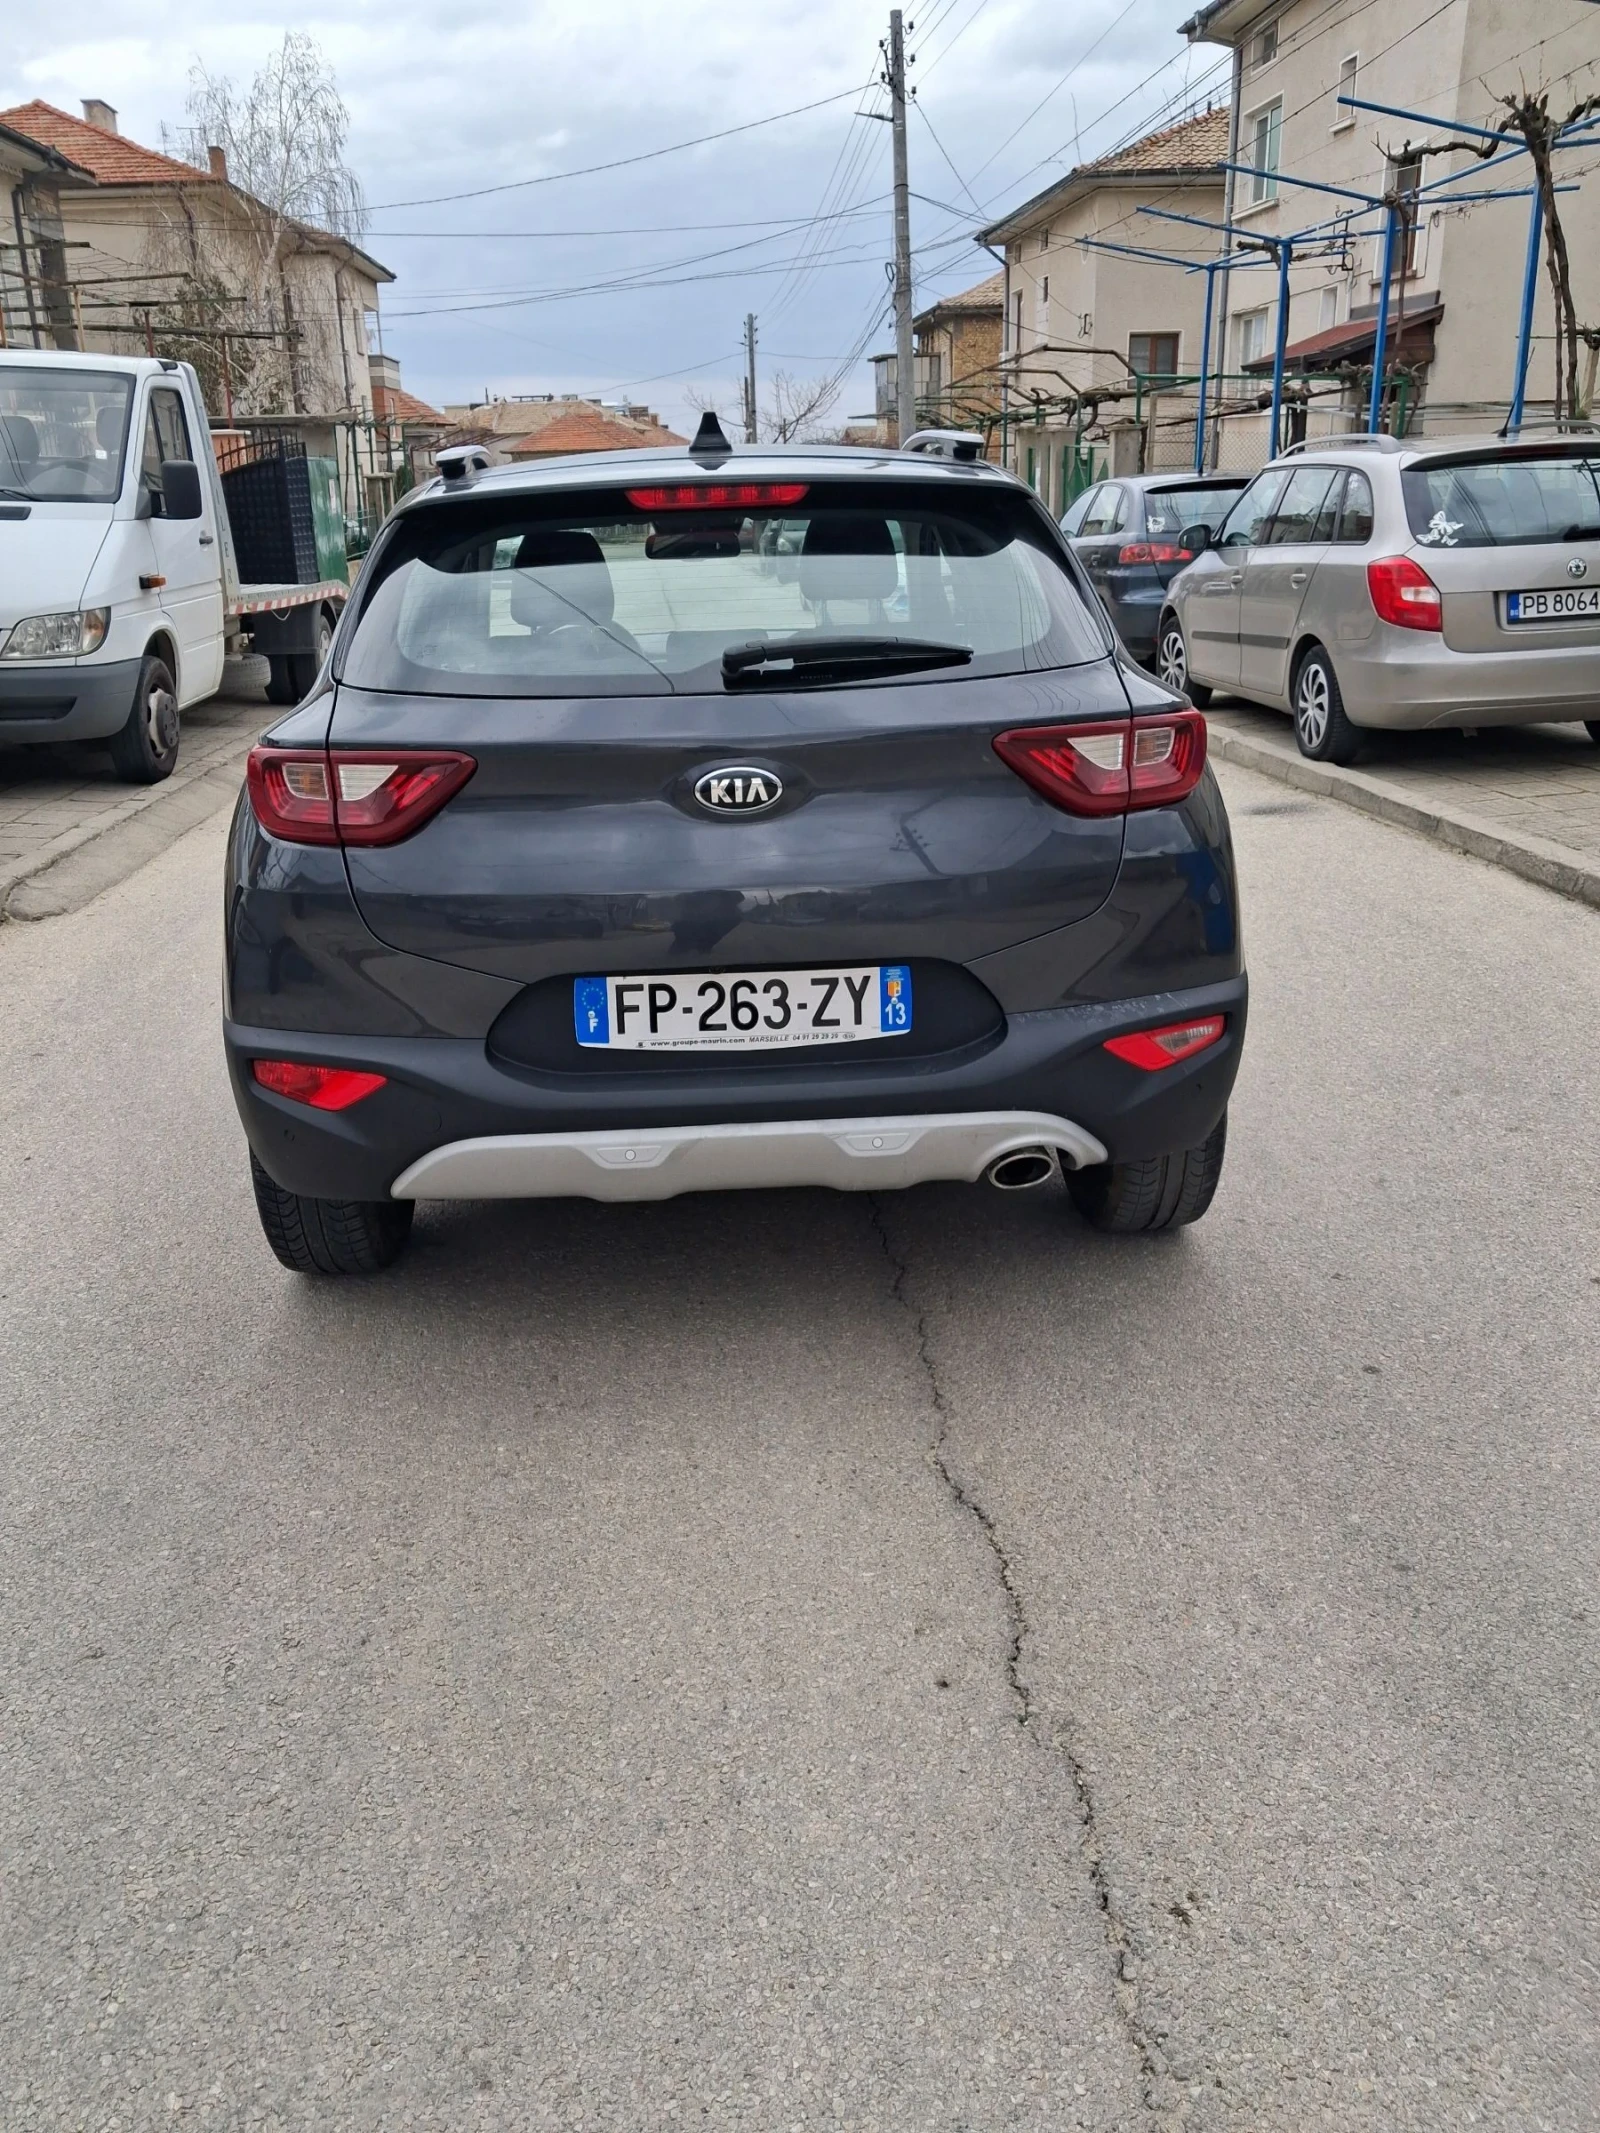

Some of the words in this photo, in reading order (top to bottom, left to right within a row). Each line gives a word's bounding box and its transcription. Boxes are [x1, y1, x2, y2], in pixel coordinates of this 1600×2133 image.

[1523, 595, 1548, 615] PB
[709, 777, 769, 803] KIA
[615, 975, 871, 1035] FP-263-ZY
[885, 1002, 906, 1025] 13
[589, 1018, 599, 1033] F
[749, 1035, 790, 1043] MARSEILLE
